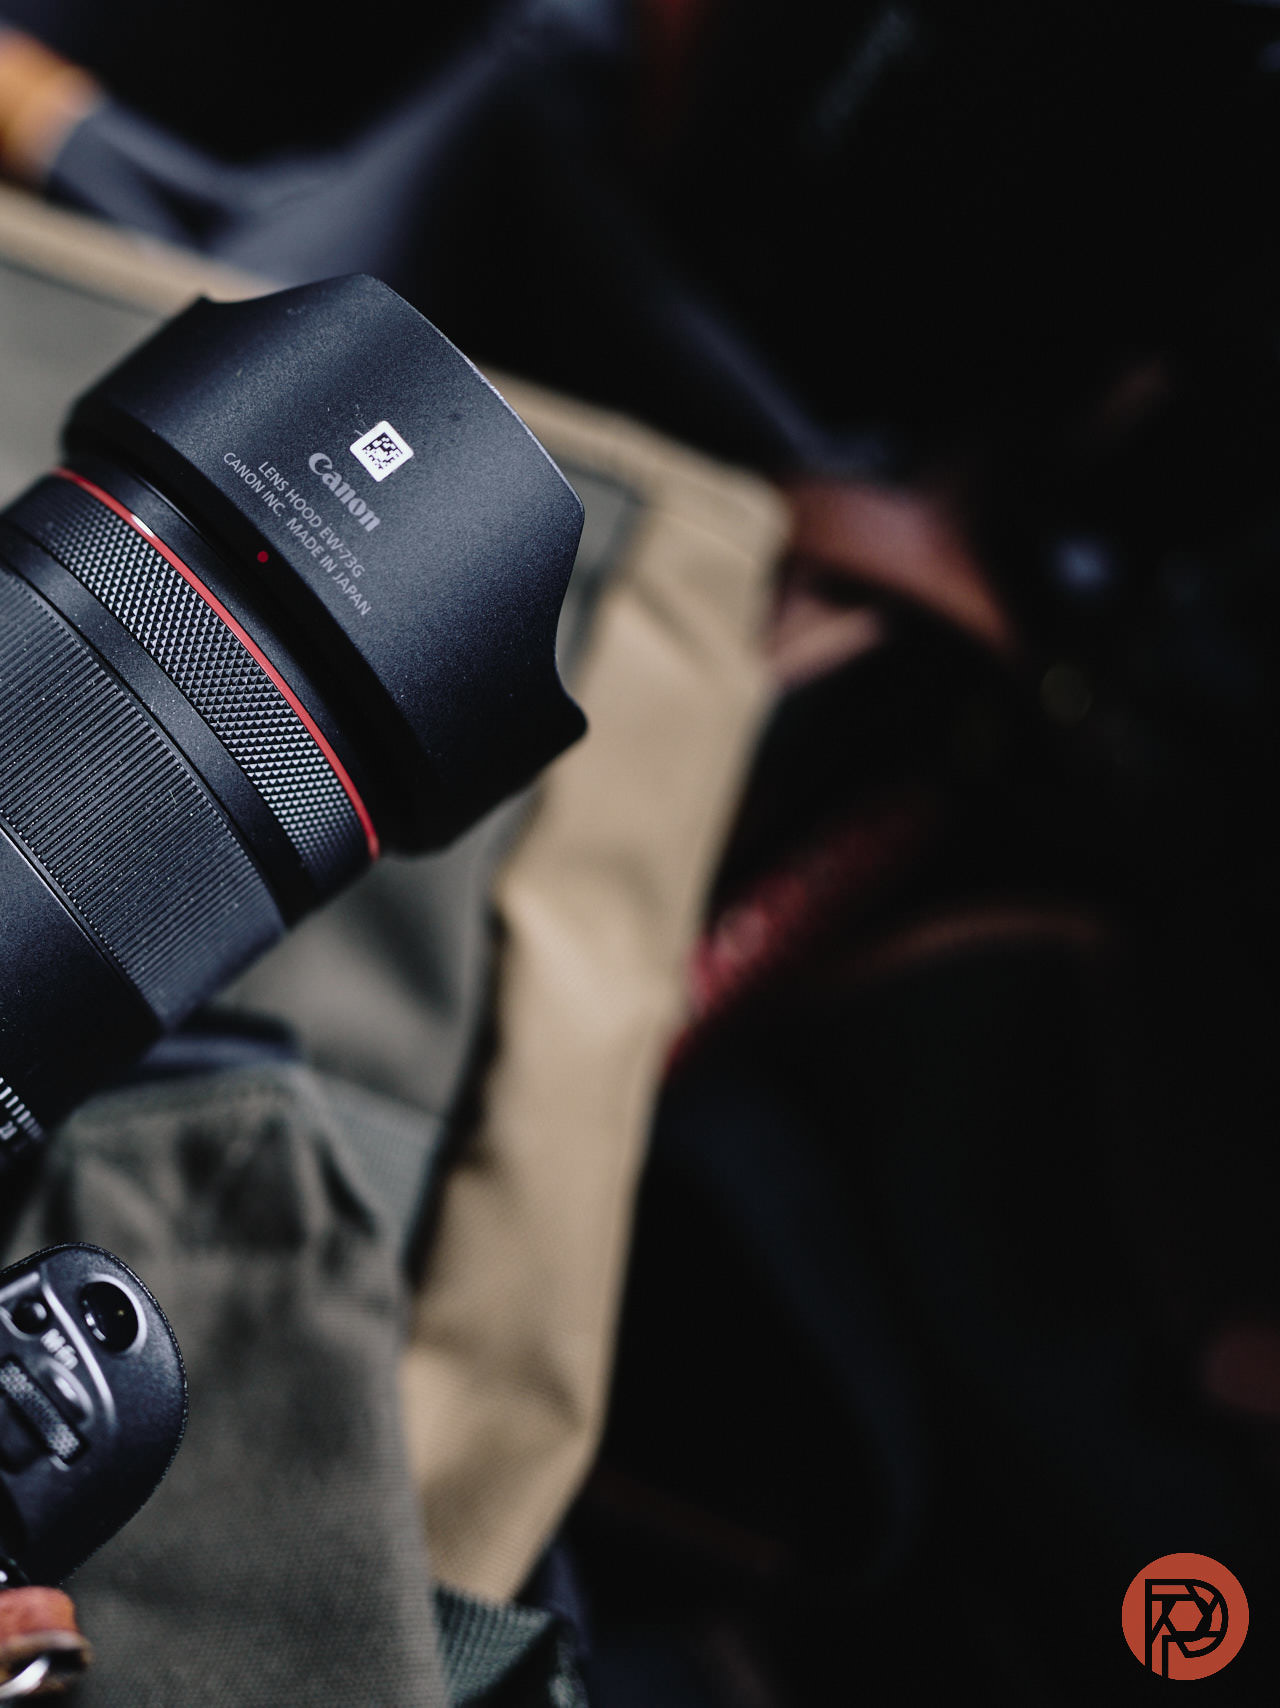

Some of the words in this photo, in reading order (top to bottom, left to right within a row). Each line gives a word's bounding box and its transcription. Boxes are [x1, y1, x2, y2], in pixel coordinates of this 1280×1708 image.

[223, 452, 266, 493] CANON
[262, 489, 286, 517] INC.
[286, 518, 321, 557] MADE
[320, 556, 338, 573] IN
[332, 572, 372, 616] JAPAN
[258, 461, 289, 492] LENS
[285, 489, 322, 528] HOOD
[320, 524, 366, 578] EW-73G
[308, 452, 380, 532] Canon
